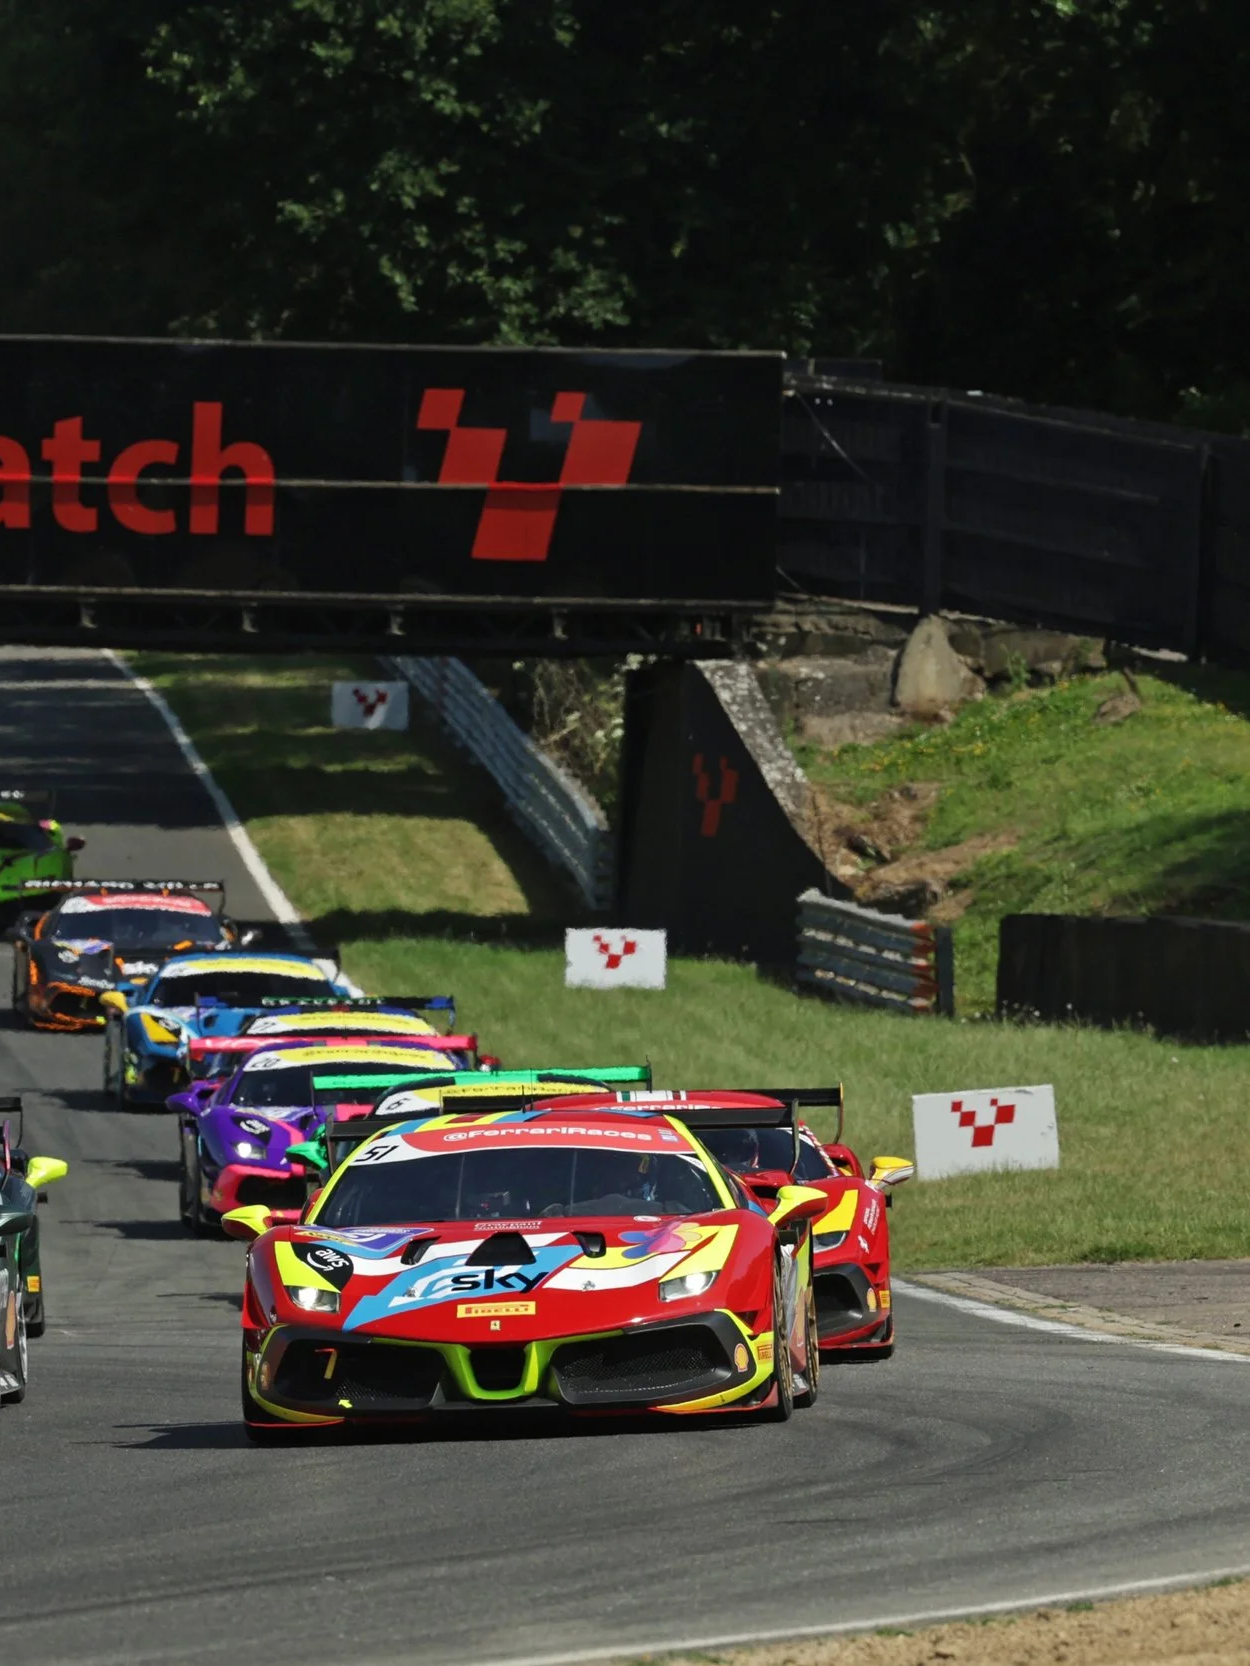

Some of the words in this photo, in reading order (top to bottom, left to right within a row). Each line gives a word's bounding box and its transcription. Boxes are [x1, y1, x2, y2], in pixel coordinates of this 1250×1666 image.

[443, 1126, 653, 1143] @FerrariRaces
[355, 1145, 399, 1162] 51
[315, 1248, 350, 1268] aws
[451, 1269, 549, 1294] sky
